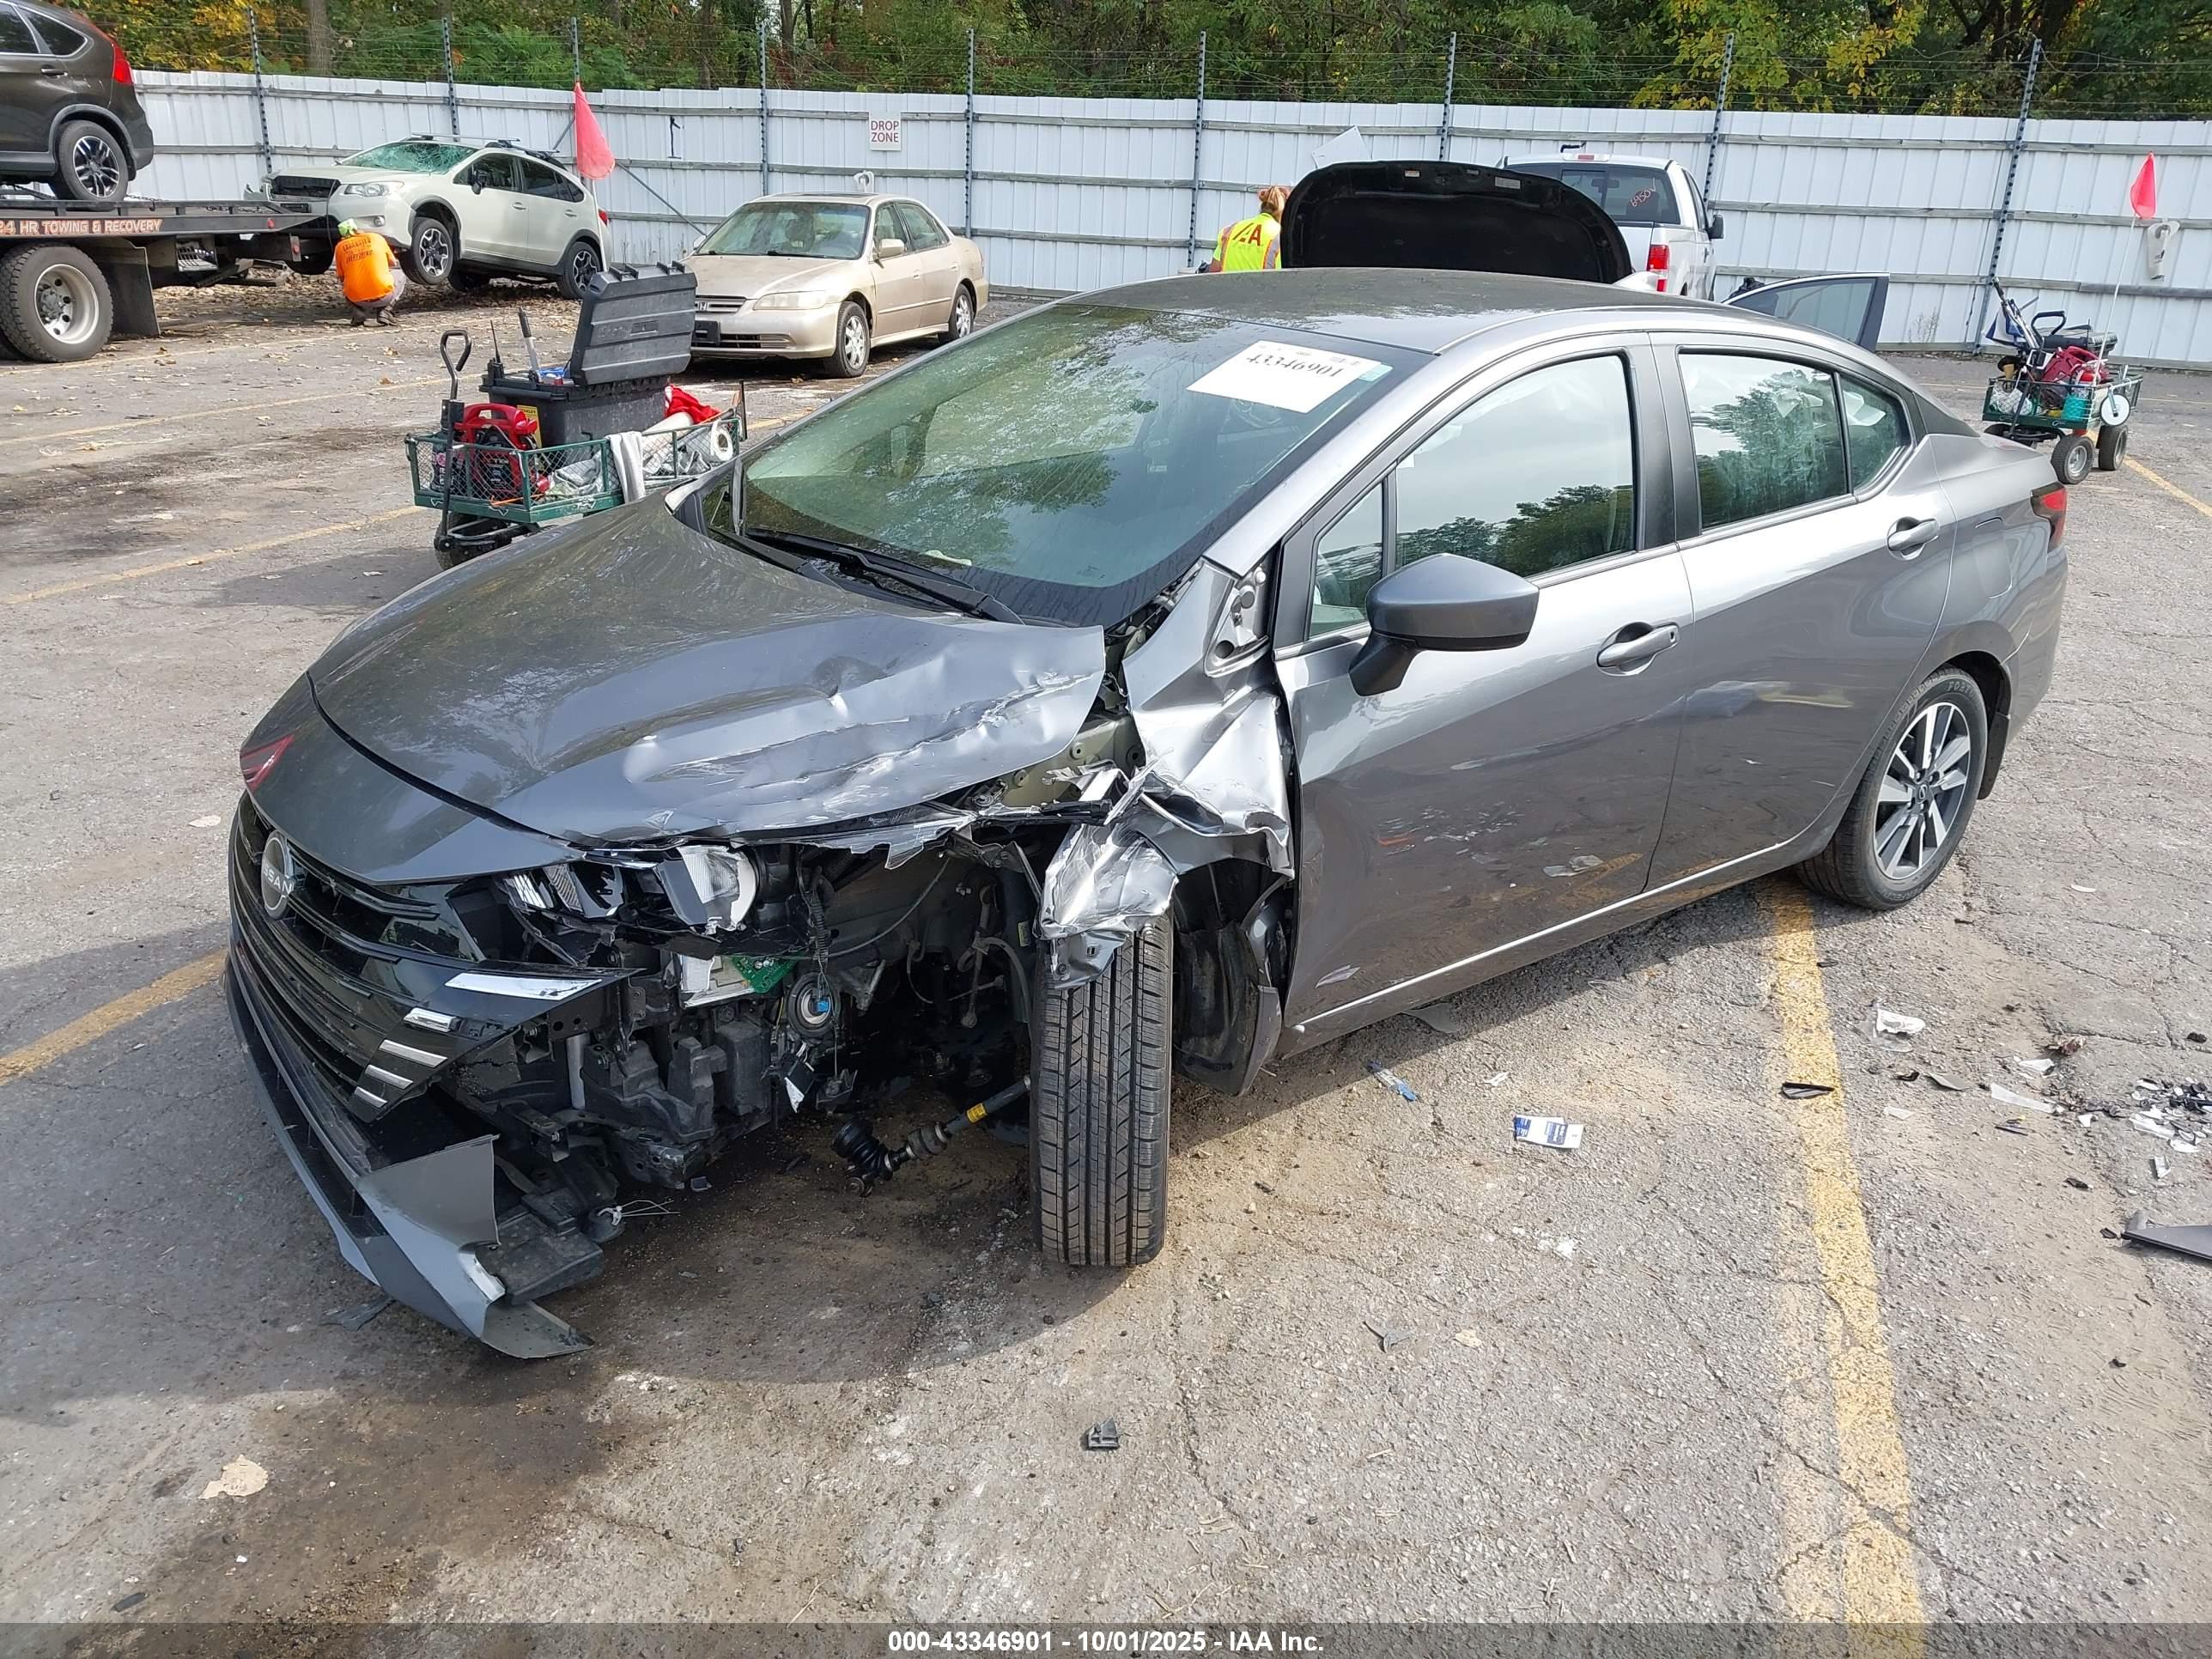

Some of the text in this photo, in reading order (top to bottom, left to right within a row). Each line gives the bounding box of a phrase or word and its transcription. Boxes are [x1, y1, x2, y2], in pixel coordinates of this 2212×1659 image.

[871, 120, 899, 131] DROP
[871, 132, 899, 143] ZONE
[20, 220, 40, 234] HR
[43, 220, 89, 234] TOWING
[92, 220, 101, 233] &
[104, 218, 163, 233] RECOVERY
[1246, 354, 1345, 378] 43346901
